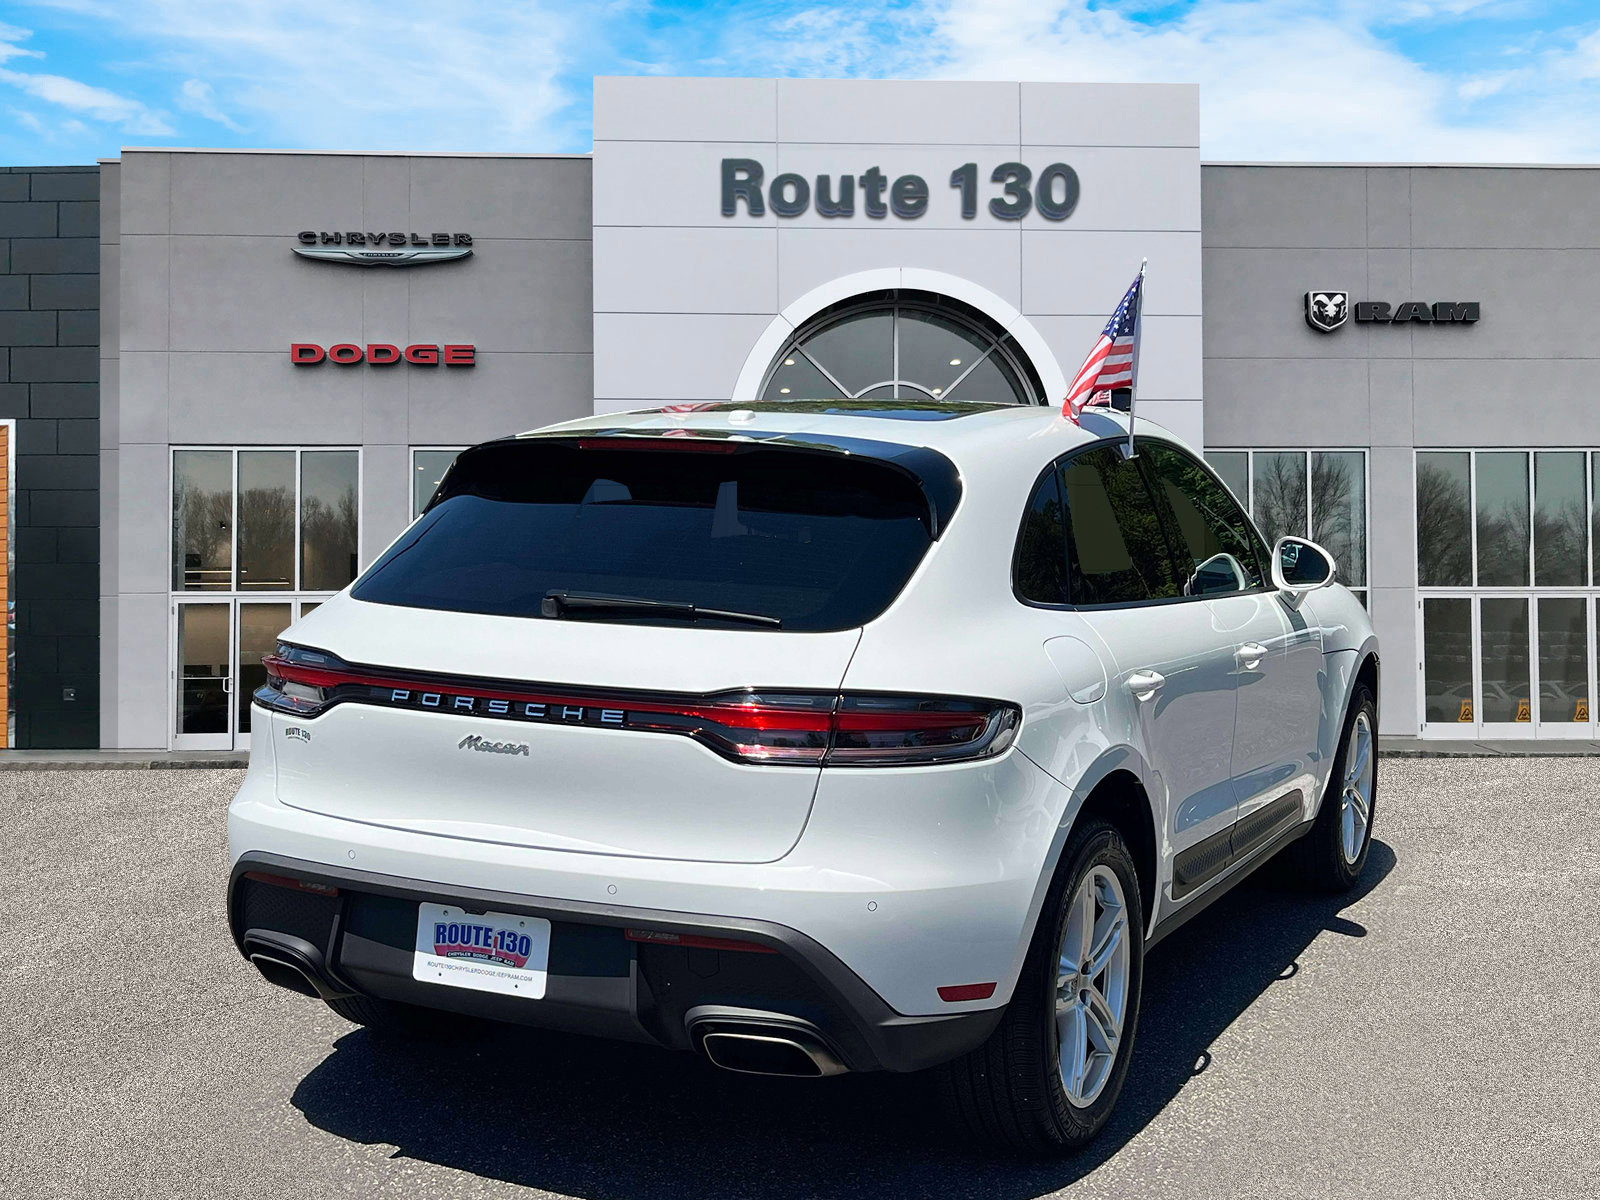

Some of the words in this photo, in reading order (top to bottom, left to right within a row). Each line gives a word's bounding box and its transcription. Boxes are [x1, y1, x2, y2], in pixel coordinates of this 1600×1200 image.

[721, 158, 929, 218] Route
[950, 162, 1080, 221] 130
[298, 231, 473, 246] CHRYSLER
[1355, 302, 1481, 324] RAM
[290, 343, 476, 366] DODGE
[391, 688, 625, 724] PORSCHE
[458, 734, 529, 756] Macan
[435, 923, 493, 948] ROUTE
[497, 930, 532, 957] 130
